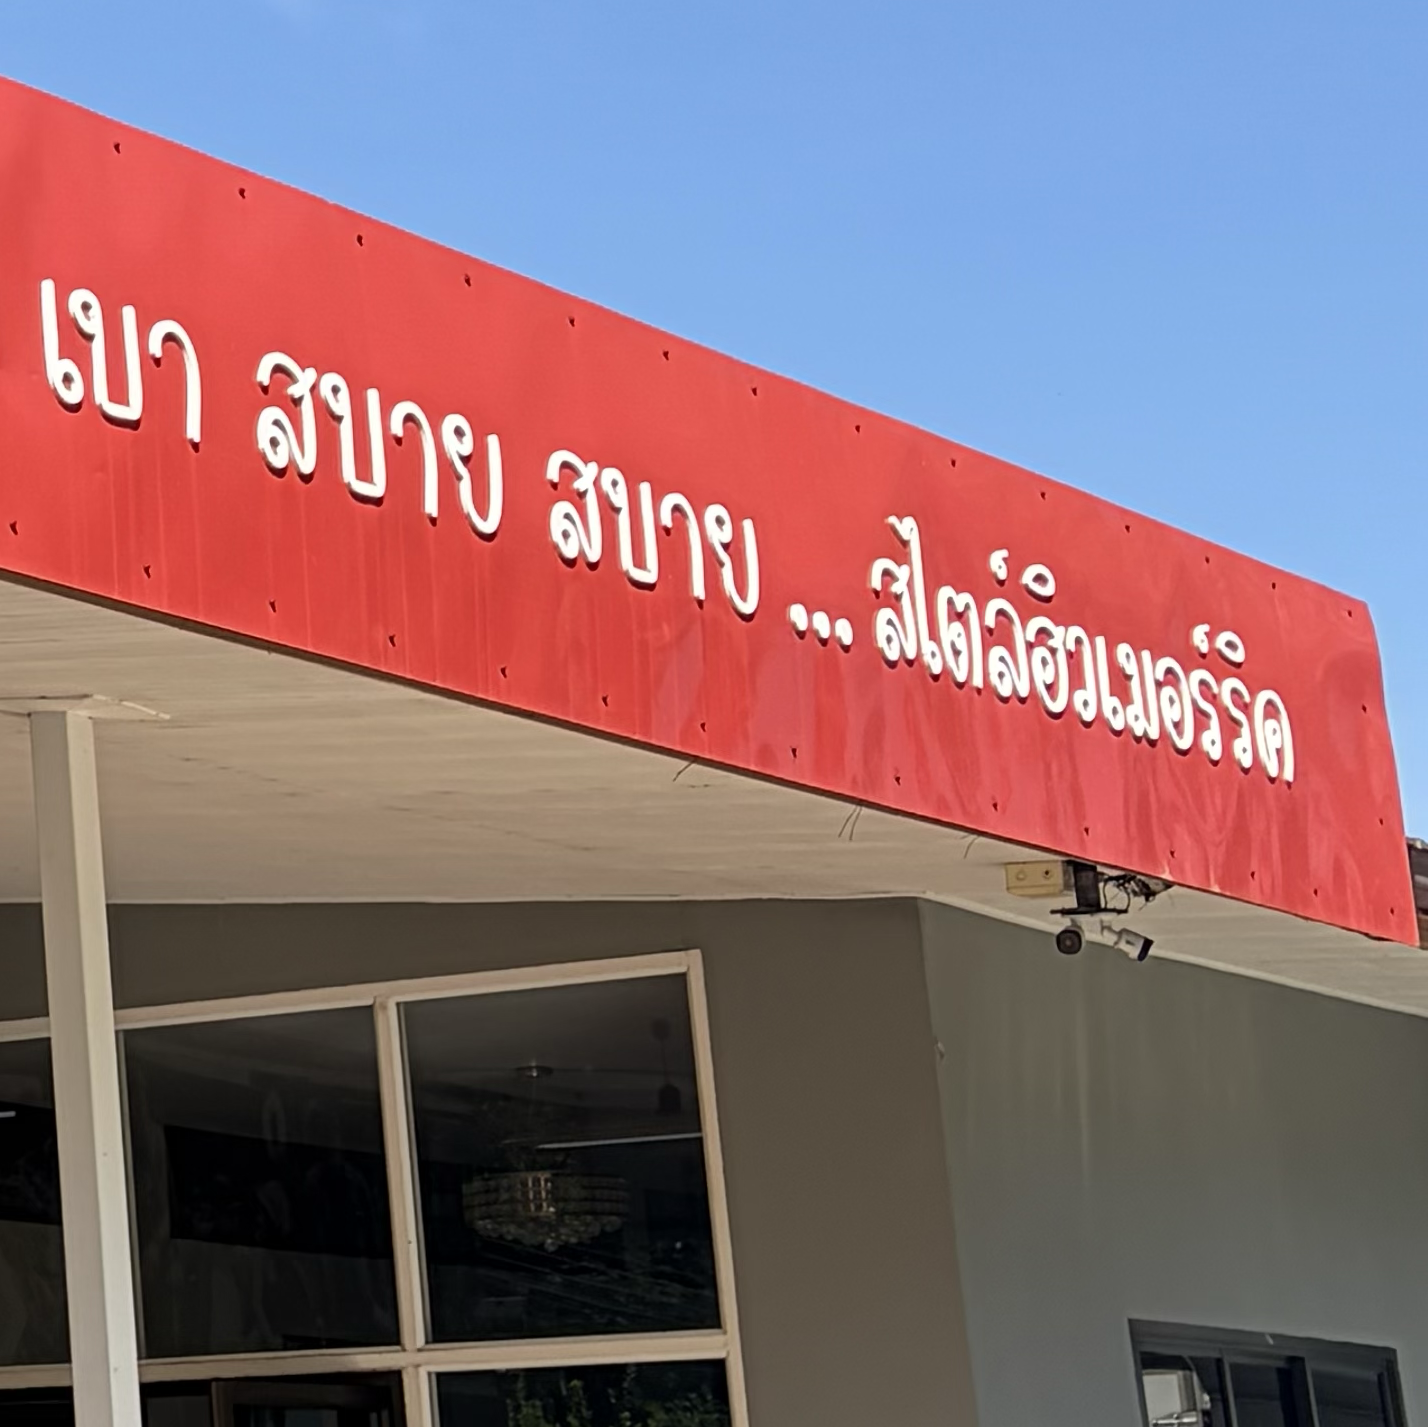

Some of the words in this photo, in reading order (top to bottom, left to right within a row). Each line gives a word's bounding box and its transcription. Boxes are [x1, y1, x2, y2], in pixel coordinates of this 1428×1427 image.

[40, 277, 203, 445] เบา
[256, 351, 504, 535] สบาย
[546, 448, 761, 618] สบาย
[870, 515, 1295, 783] สไตล์ฮิวเมอร์ริค
